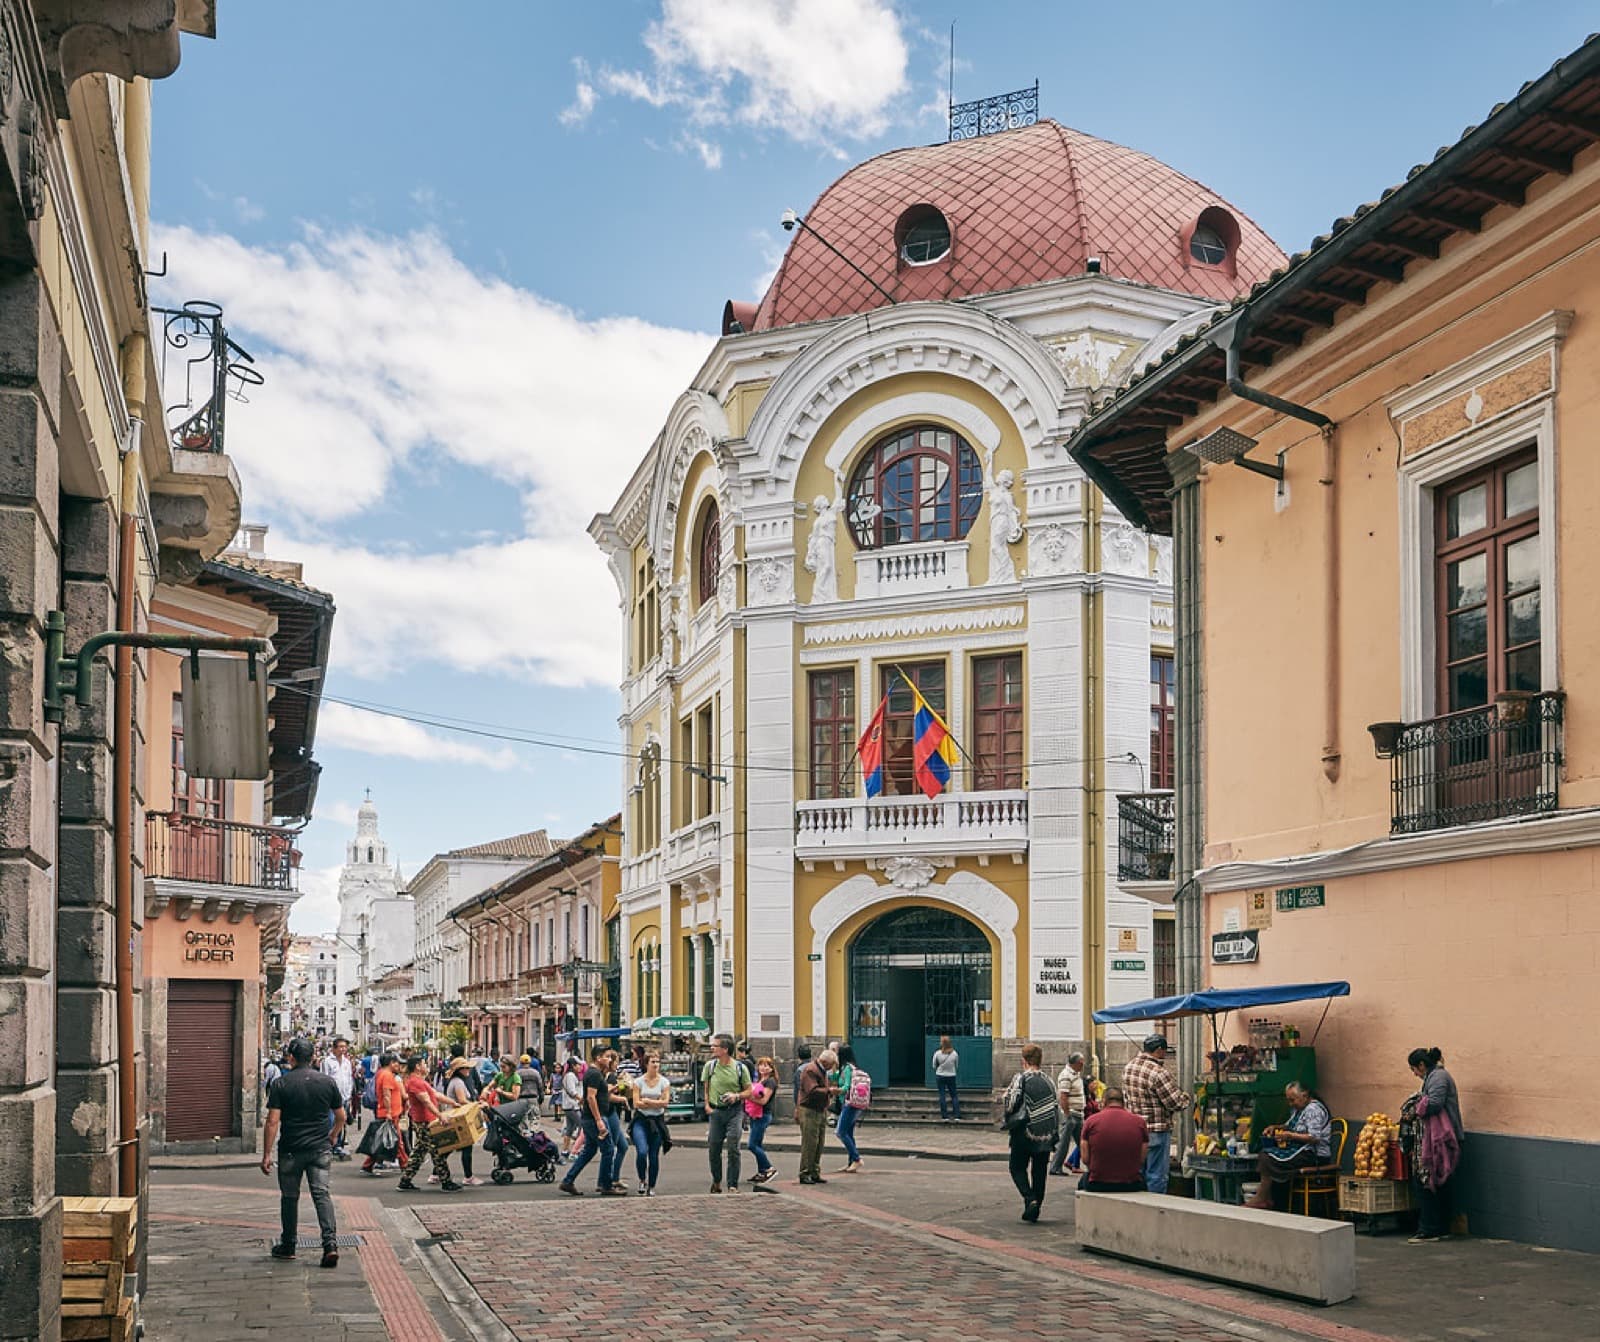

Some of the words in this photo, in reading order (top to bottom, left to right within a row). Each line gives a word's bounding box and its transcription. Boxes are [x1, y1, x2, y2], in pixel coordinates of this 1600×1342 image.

[185, 948, 234, 962] LIDER
[1043, 958, 1068, 968] MUSEO
[1040, 971, 1071, 981] ESCUELA
[1035, 983, 1048, 994] DEL
[1049, 983, 1077, 994] PASILLO
